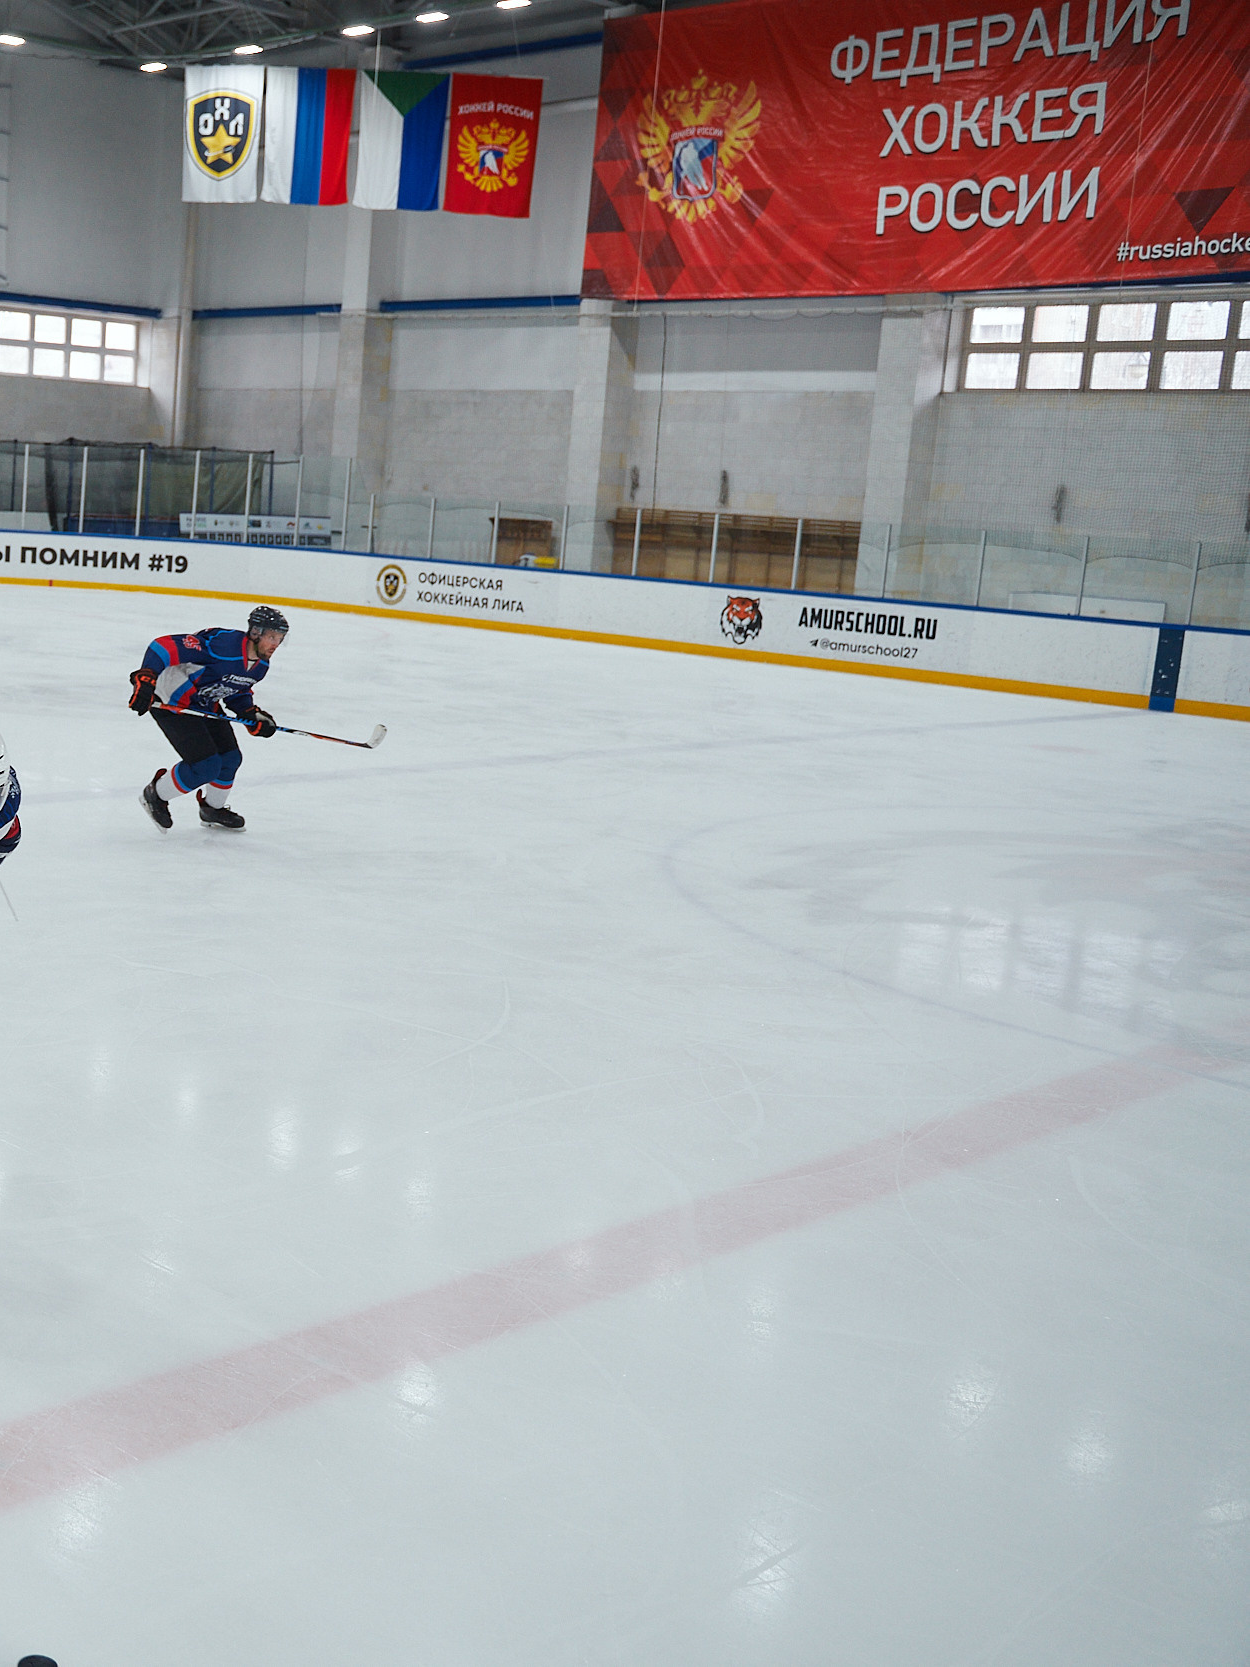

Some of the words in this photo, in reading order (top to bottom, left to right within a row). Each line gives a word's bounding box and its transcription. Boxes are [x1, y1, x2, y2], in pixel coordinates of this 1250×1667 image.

[829, 0, 1191, 87] ФЕДЕРАЦИЯ
[496, 102, 534, 120] РОССИИ
[879, 82, 1108, 158] ХОККЕЯ
[875, 167, 1101, 235] РОССИИ
[20, 546, 140, 570] ПОМНИМ
[148, 554, 188, 573] #19
[418, 572, 503, 591] ОФИЦЕРСКАЯ
[416, 591, 488, 609] ХОККЕЙНАЯ
[492, 599, 524, 613] ЛИГА
[799, 607, 938, 640] AMURSCHOOL.RU
[820, 638, 918, 659] @amurschool27
